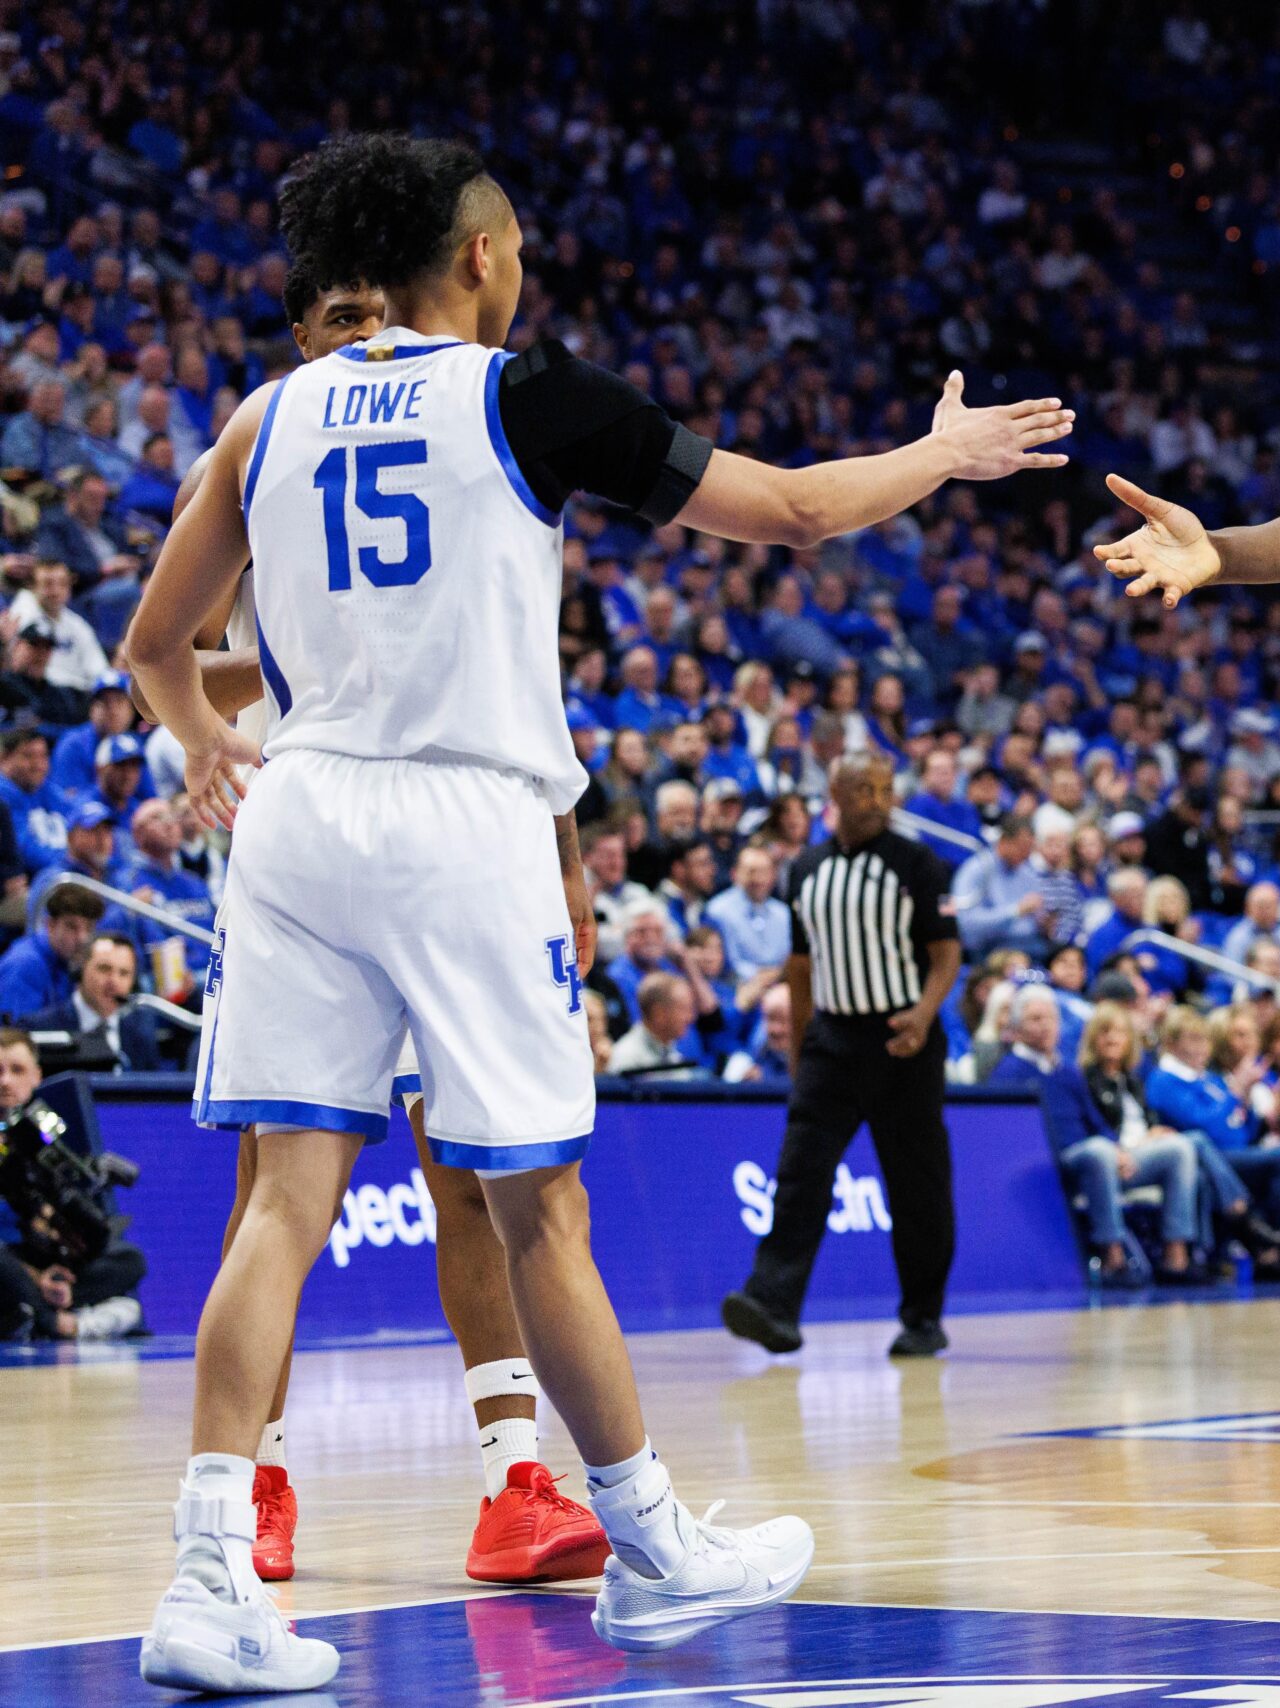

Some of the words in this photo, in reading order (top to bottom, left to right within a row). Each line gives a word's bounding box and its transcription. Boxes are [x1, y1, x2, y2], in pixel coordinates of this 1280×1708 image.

[323, 379, 427, 428] LOWE
[313, 439, 432, 592] 15
[329, 1167, 437, 1268] pect
